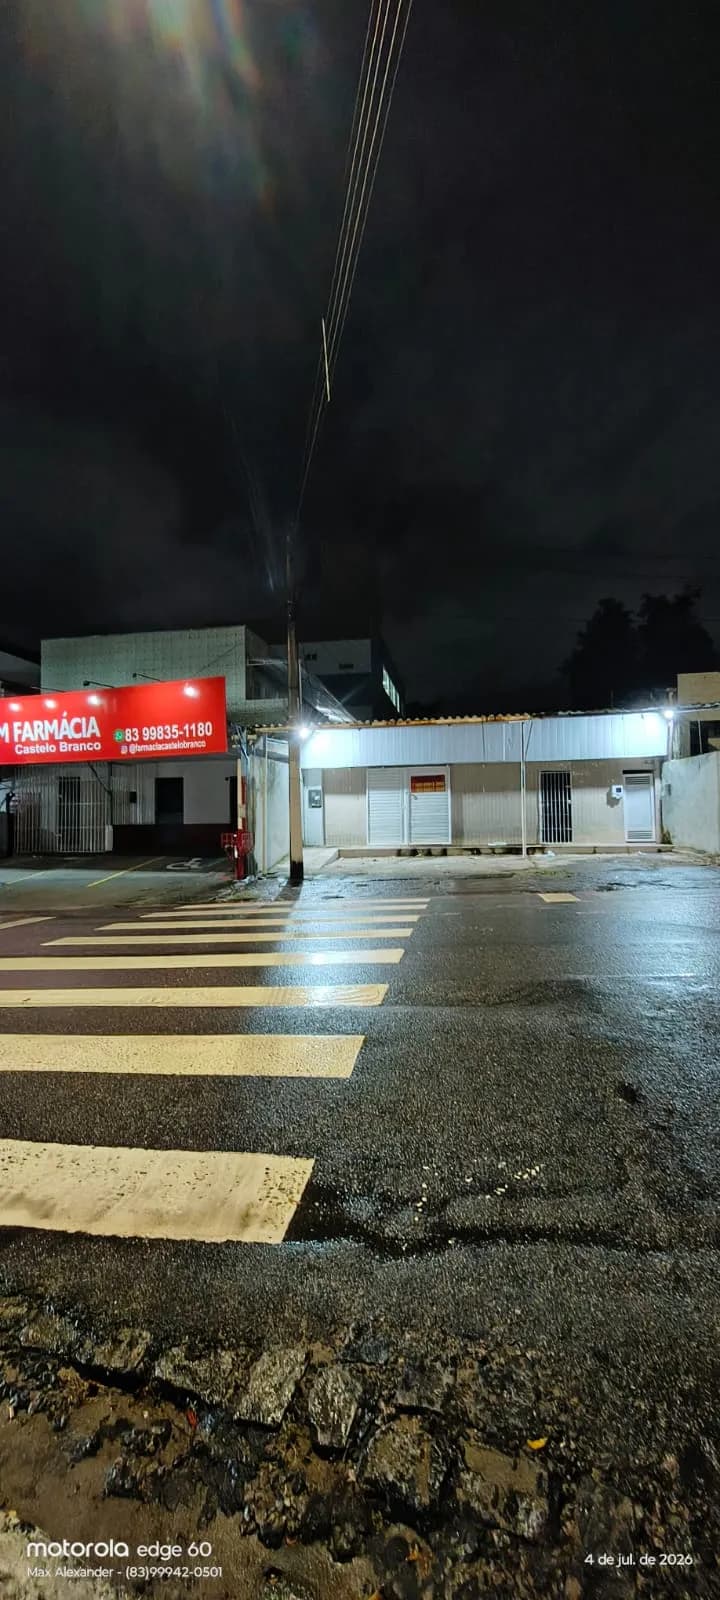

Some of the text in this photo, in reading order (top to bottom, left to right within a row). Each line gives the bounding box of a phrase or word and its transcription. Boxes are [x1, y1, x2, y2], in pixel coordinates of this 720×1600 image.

[13, 710, 101, 742] FARMÁCIA
[125, 721, 213, 742] 83 99835-1180
[15, 741, 101, 755] Castelo Branco
